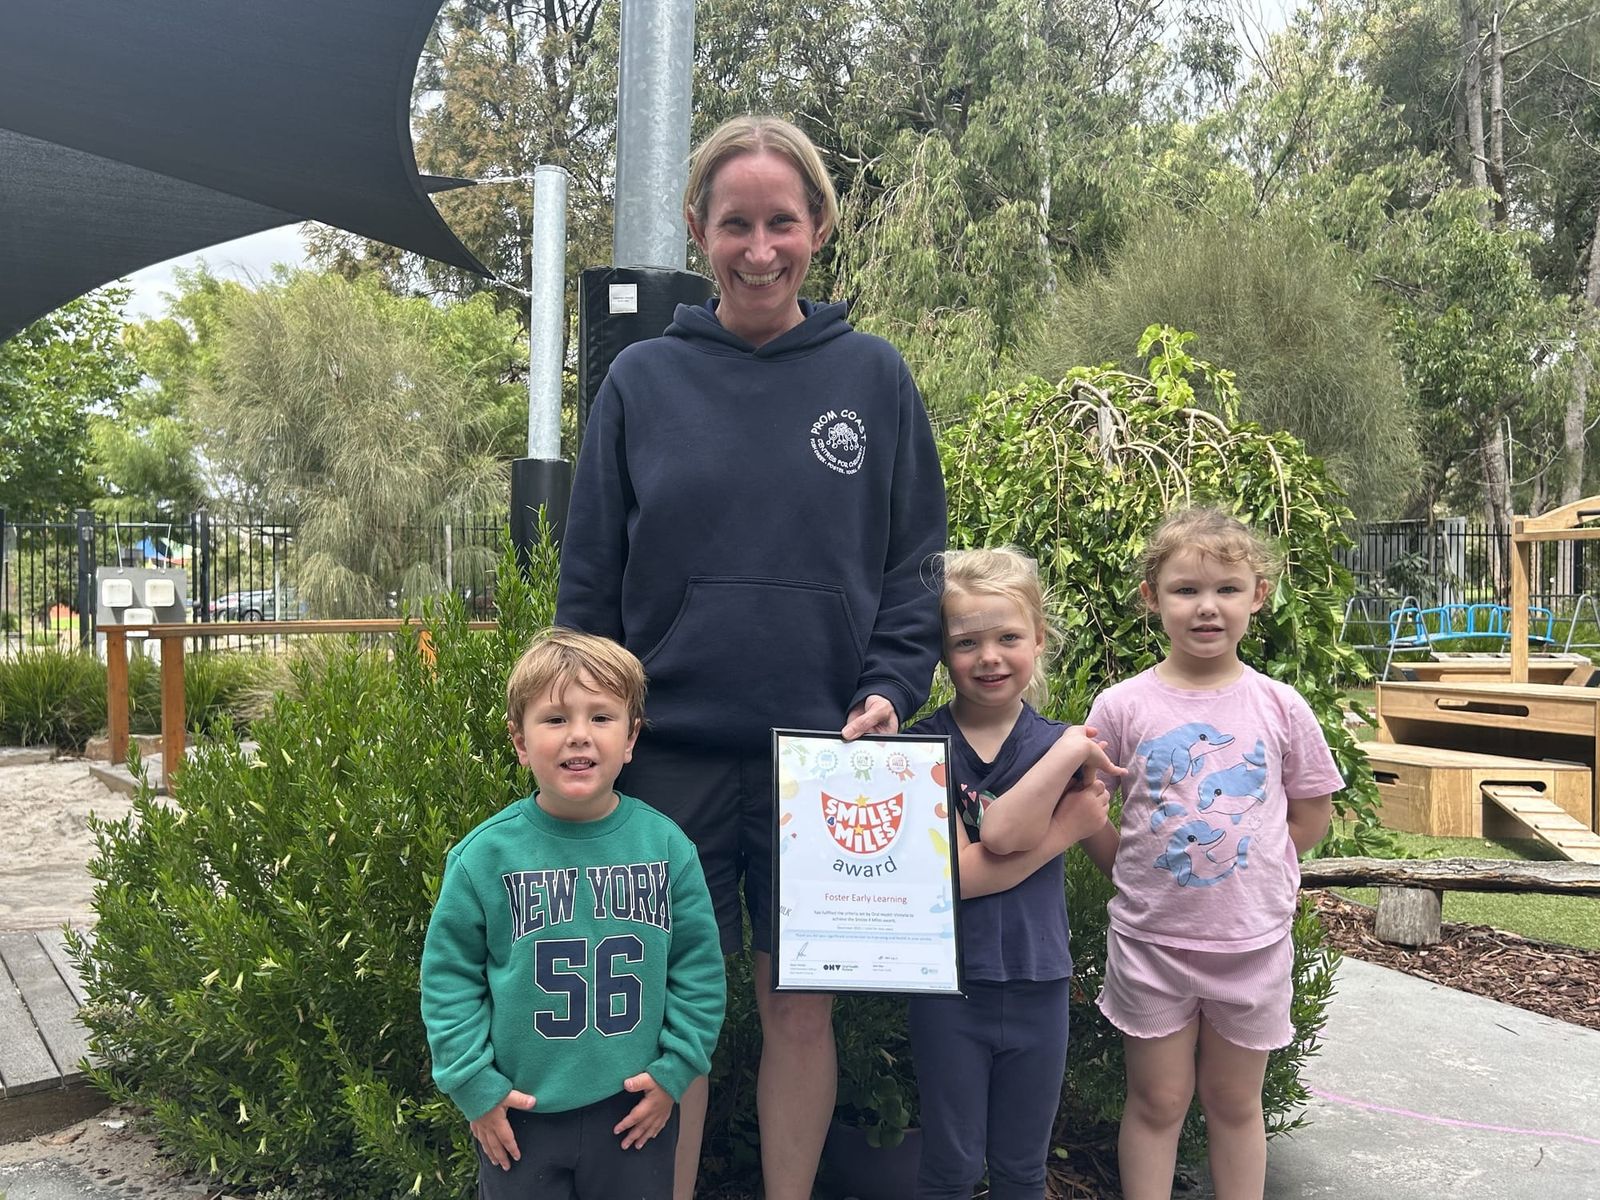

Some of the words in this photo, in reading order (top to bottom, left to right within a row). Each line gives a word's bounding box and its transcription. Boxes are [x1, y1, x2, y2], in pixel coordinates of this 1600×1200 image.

[810, 410, 838, 435] PROM
[840, 409, 867, 442] COAST
[837, 459, 849, 469] FOR
[825, 798, 901, 827] SMILES
[827, 815, 837, 828] 4
[834, 821, 896, 852] MILES
[832, 855, 898, 878] award
[502, 868, 578, 947] NEW
[586, 861, 671, 933] YORK
[824, 893, 849, 902] Foster
[851, 894, 871, 903] Early
[873, 895, 908, 904] Learning
[534, 934, 644, 1039] 56
